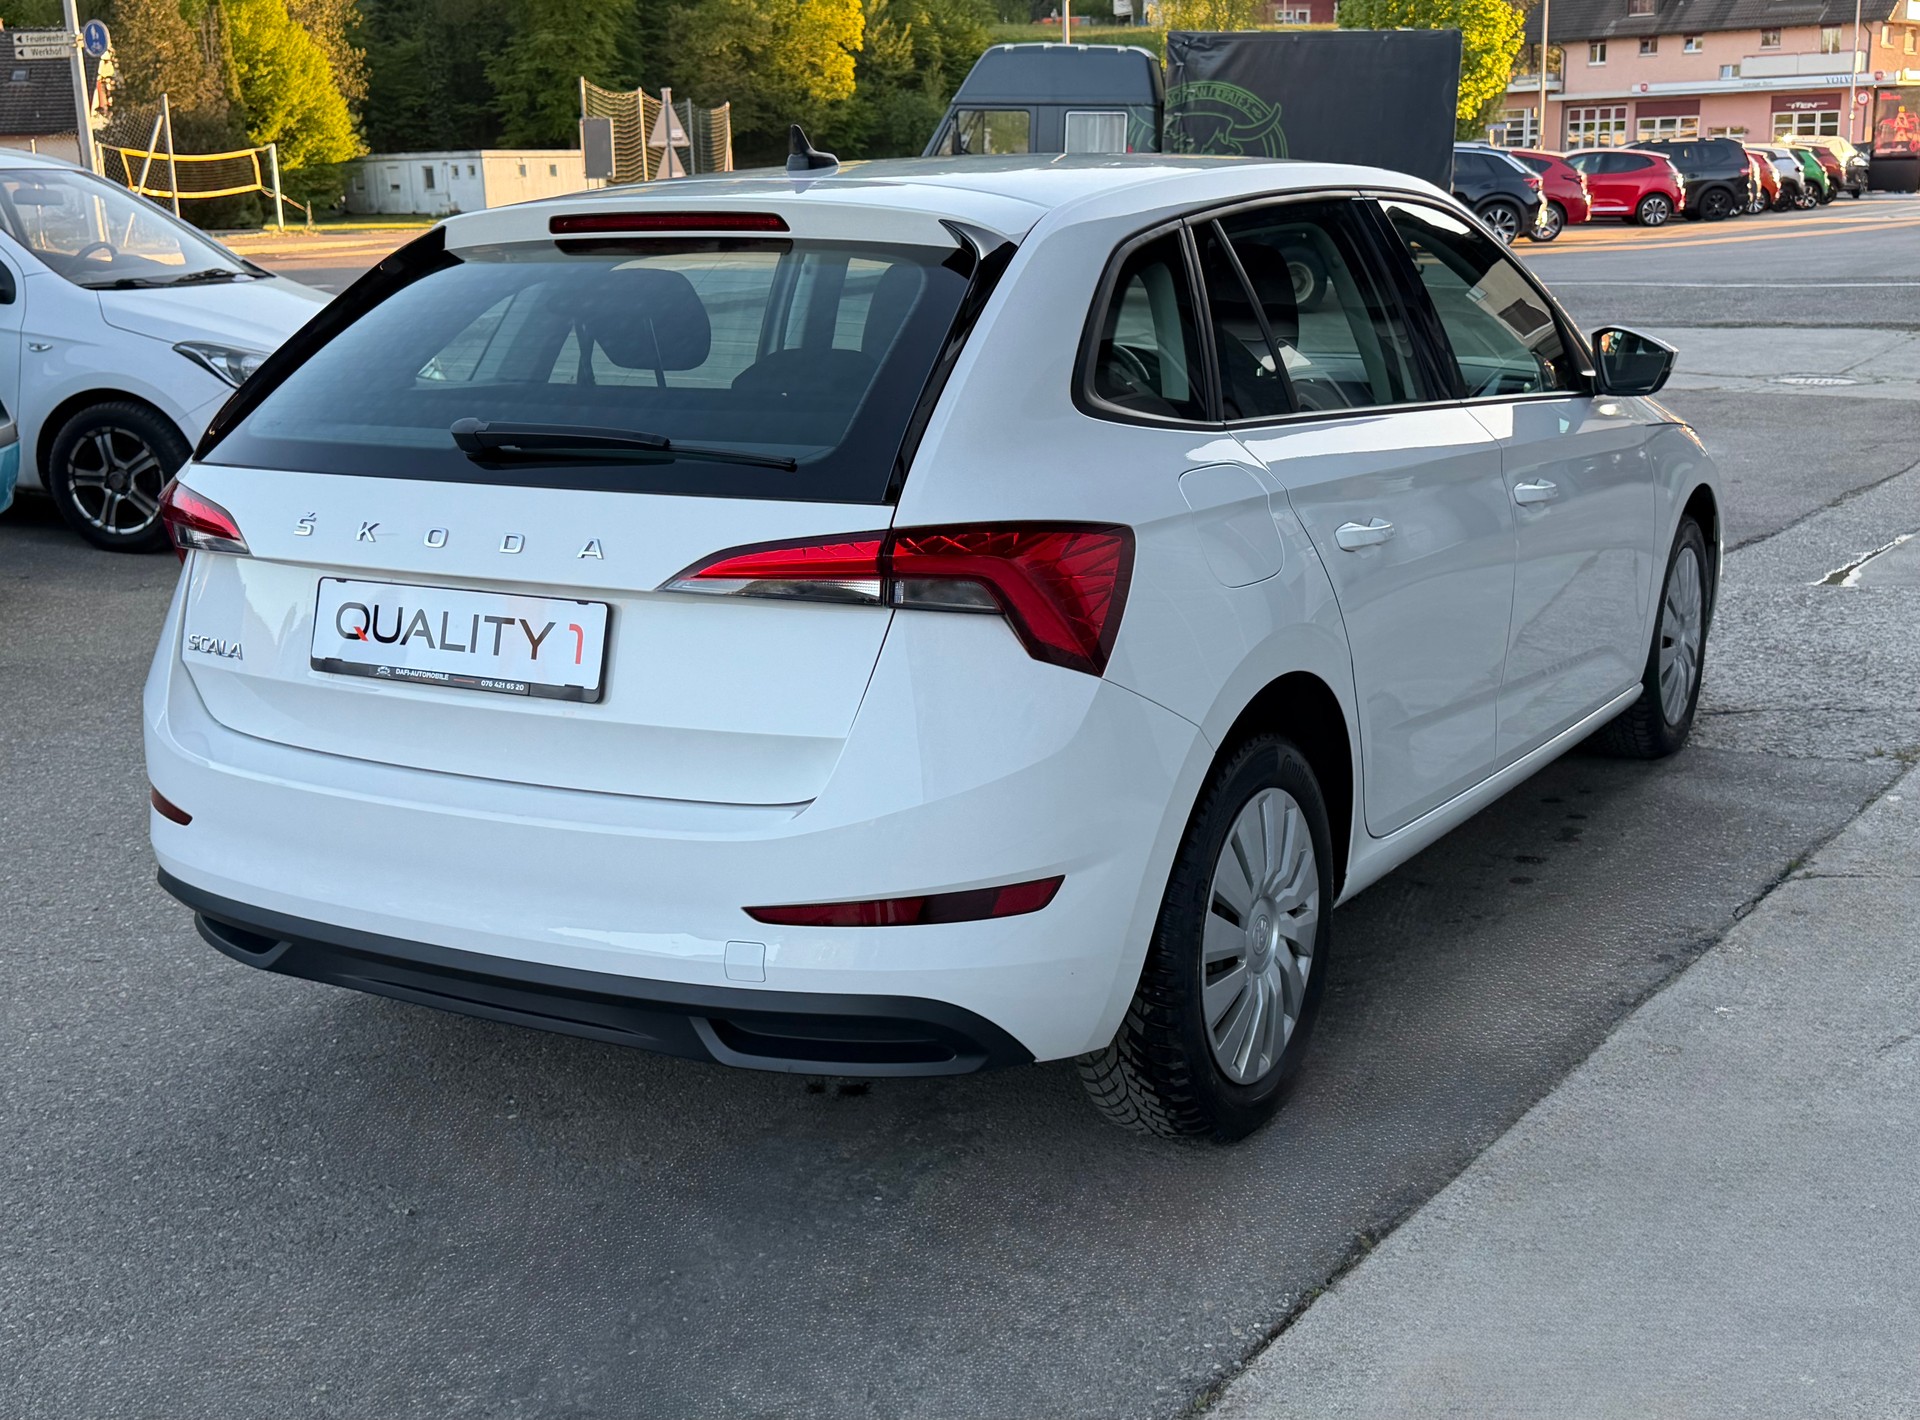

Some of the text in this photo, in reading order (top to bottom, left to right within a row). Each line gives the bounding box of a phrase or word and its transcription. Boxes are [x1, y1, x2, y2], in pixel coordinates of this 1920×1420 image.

[25, 34, 64, 43] Feuerwehr
[30, 47, 62, 57] Werkhof
[335, 601, 584, 665] QUALITY 1
[188, 633, 243, 661] SCALA
[395, 668, 449, 681] DAFI-AUTOMOBILE
[481, 680, 493, 688] 076
[494, 681, 505, 689] 421
[506, 682, 515, 690] 65
[515, 683, 525, 691] 20
